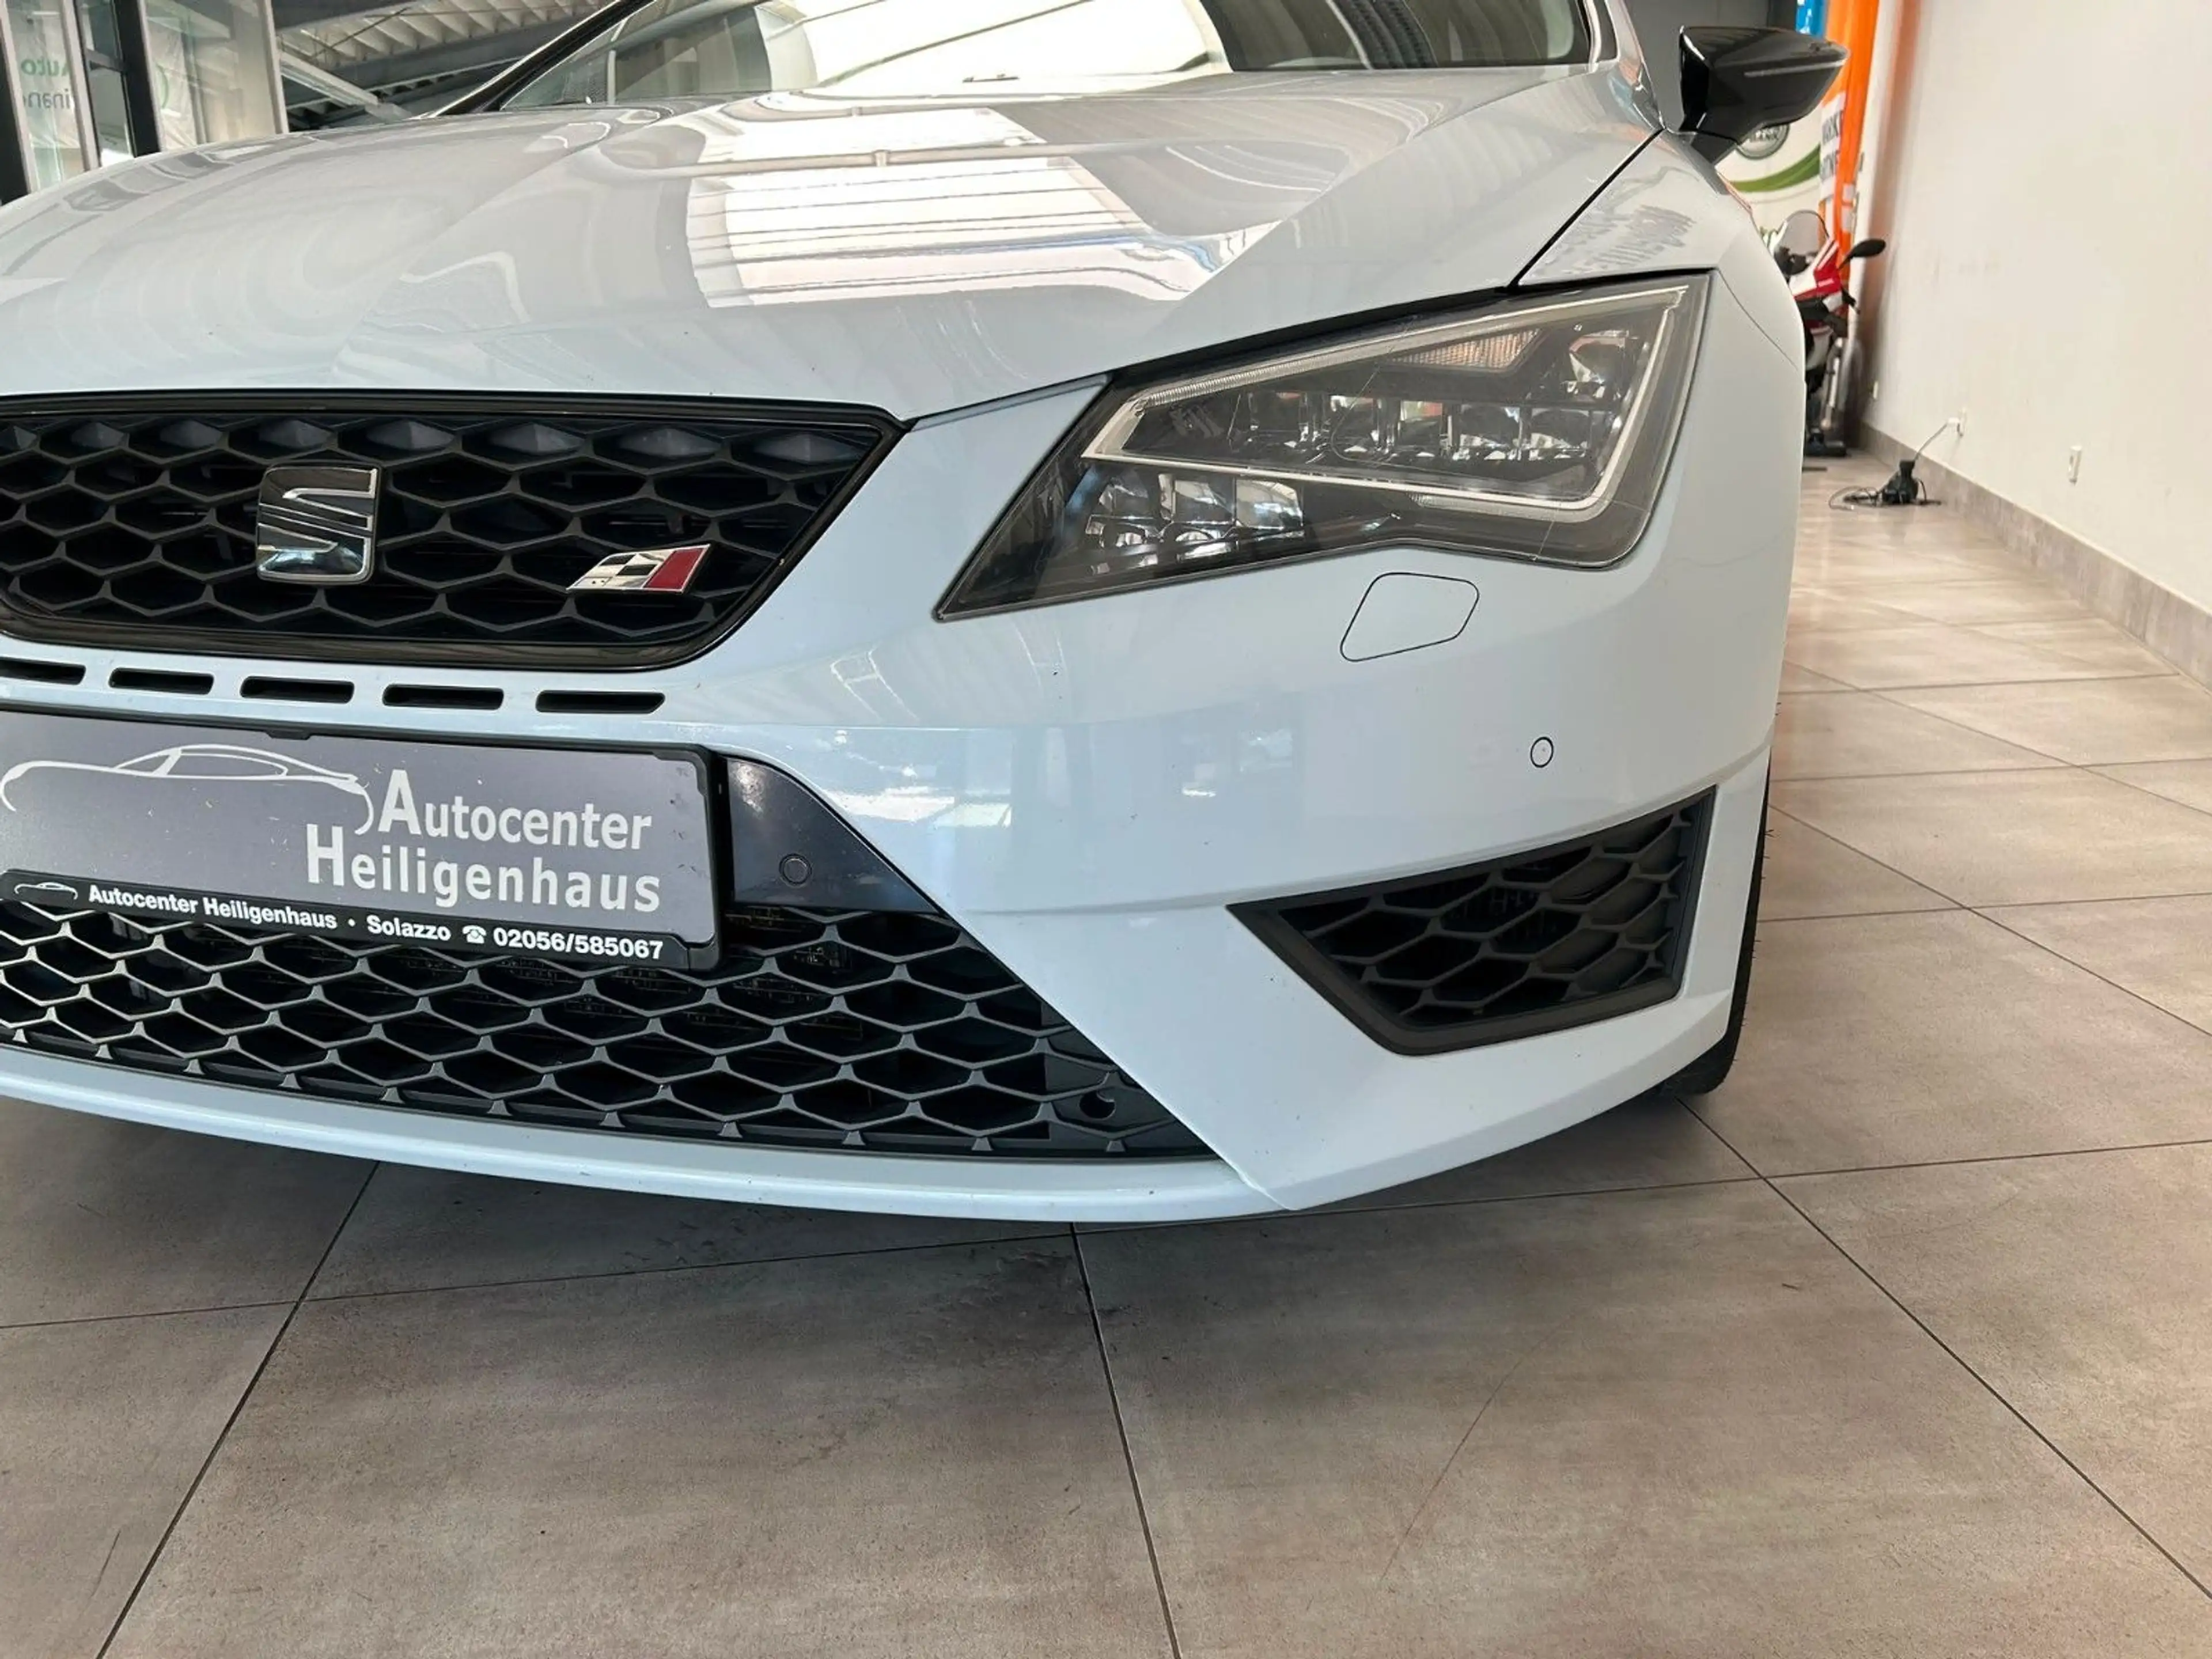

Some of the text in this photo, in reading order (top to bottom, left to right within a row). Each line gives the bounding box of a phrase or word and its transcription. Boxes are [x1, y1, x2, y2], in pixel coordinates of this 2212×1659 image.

[378, 769, 652, 850] Autocenter
[306, 823, 660, 912] Heiligenhaus
[89, 884, 664, 959] Autocenter Heiligenhaus Solazzo 02056/585067
